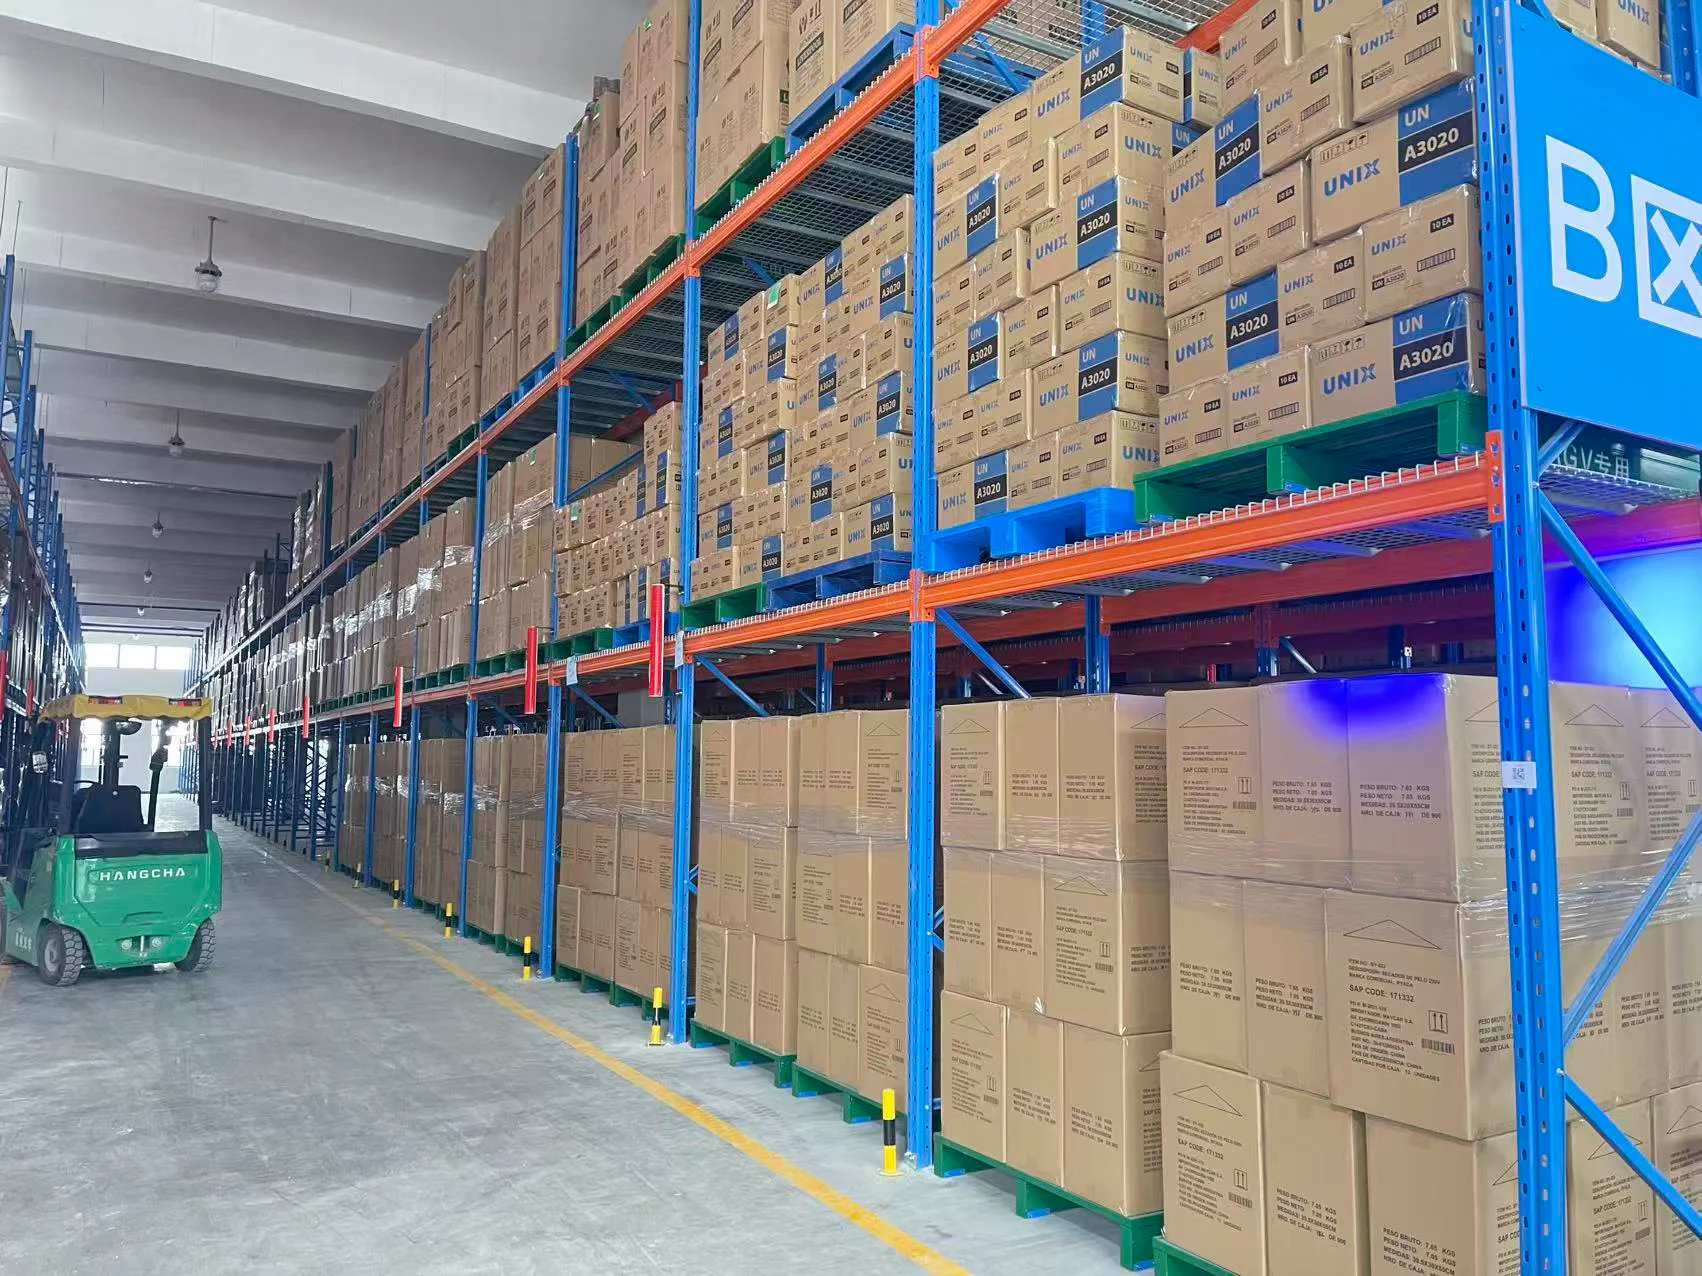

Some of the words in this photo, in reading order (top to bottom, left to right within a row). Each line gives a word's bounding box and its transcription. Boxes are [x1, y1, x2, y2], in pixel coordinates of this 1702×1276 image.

[1617, 0, 1650, 26] UNIX
[1225, 36, 1248, 60] UNIX
[1360, 29, 1395, 56] UNIX
[1084, 46, 1099, 64] UN
[1129, 46, 1153, 65] UNIX
[1083, 62, 1115, 91] A3020
[1198, 69, 1219, 84] UNIX
[1037, 88, 1071, 119] UNIX
[1266, 88, 1294, 112] UNIX
[1404, 104, 1429, 127] UN
[983, 123, 1003, 140] UNIX
[1176, 128, 1191, 144] UN
[1218, 121, 1234, 140] UN
[1062, 142, 1083, 160] UNIX
[1124, 136, 1162, 160] UNIX
[1218, 137, 1252, 170] A3020
[1404, 127, 1460, 162] A3020
[1170, 168, 1206, 203] UNIX
[1324, 158, 1381, 197] UNIX
[968, 189, 980, 206] UN
[1080, 195, 1095, 211] UN
[1125, 196, 1150, 211] UNIX
[968, 205, 991, 229] A3020
[1080, 212, 1111, 237] A3020
[1233, 206, 1260, 227] UNIX
[1432, 221, 1441, 231] 10
[1441, 217, 1452, 228] EA
[937, 225, 961, 251] UNIX
[1036, 232, 1068, 260] UNIX
[1371, 233, 1407, 256] UNIX
[1167, 244, 1191, 263] UNIX
[882, 267, 892, 279] UN
[1335, 262, 1344, 272] 10
[1344, 258, 1353, 269] EA
[881, 281, 901, 299] A3020
[1284, 273, 1315, 294] UNIX
[853, 296, 874, 314] UNIX
[1064, 288, 1085, 304] UNIX
[1126, 287, 1165, 308] UNIX
[1230, 292, 1248, 310] UN
[1008, 318, 1027, 333] UNIX
[1230, 313, 1269, 340] A3020
[1400, 314, 1424, 335] UN
[970, 328, 982, 341] UN
[768, 349, 783, 363] A3020
[970, 344, 993, 365] A3020
[1082, 348, 1096, 362] UN
[1175, 334, 1215, 364] UNIX
[1400, 340, 1453, 371] A3020
[1125, 352, 1150, 366] UNIX
[937, 360, 961, 382] UNIX
[1081, 367, 1111, 389] A3020
[1280, 376, 1287, 386] 10
[1288, 373, 1297, 384] EA
[1323, 363, 1377, 395] UNIX
[819, 377, 835, 394] A3020
[1232, 384, 1261, 401] UNIX
[1039, 383, 1069, 407] UNIX
[878, 398, 896, 415] A3020
[853, 412, 871, 428] UNIX
[1164, 410, 1189, 426] UNIX
[1062, 441, 1082, 455] UNIX
[1122, 446, 1160, 464] UNIX
[768, 451, 783, 466] A3020
[812, 470, 821, 481] UN
[977, 463, 988, 474] UN
[812, 486, 829, 501] A3020
[977, 481, 1001, 499] A3020
[872, 503, 881, 514] UN
[942, 492, 967, 511] UNIX
[848, 529, 866, 543] UNIX
[872, 520, 890, 536] A3020
[762, 556, 778, 570] A3020
[99, 867, 186, 882] HANGCHA
[1349, 984, 1364, 993] SAP
[1365, 987, 1388, 998] CODE:
[1390, 991, 1415, 1003] 171332
[1413, 1071, 1440, 1082] UNIDADES
[1325, 1207, 1337, 1216] KGS
[1325, 1215, 1338, 1225] KGS
[1383, 1227, 1399, 1238] PESO
[1441, 1248, 1456, 1258] KGS
[1383, 1236, 1399, 1247] PESO
[1442, 1258, 1457, 1267] KGS
